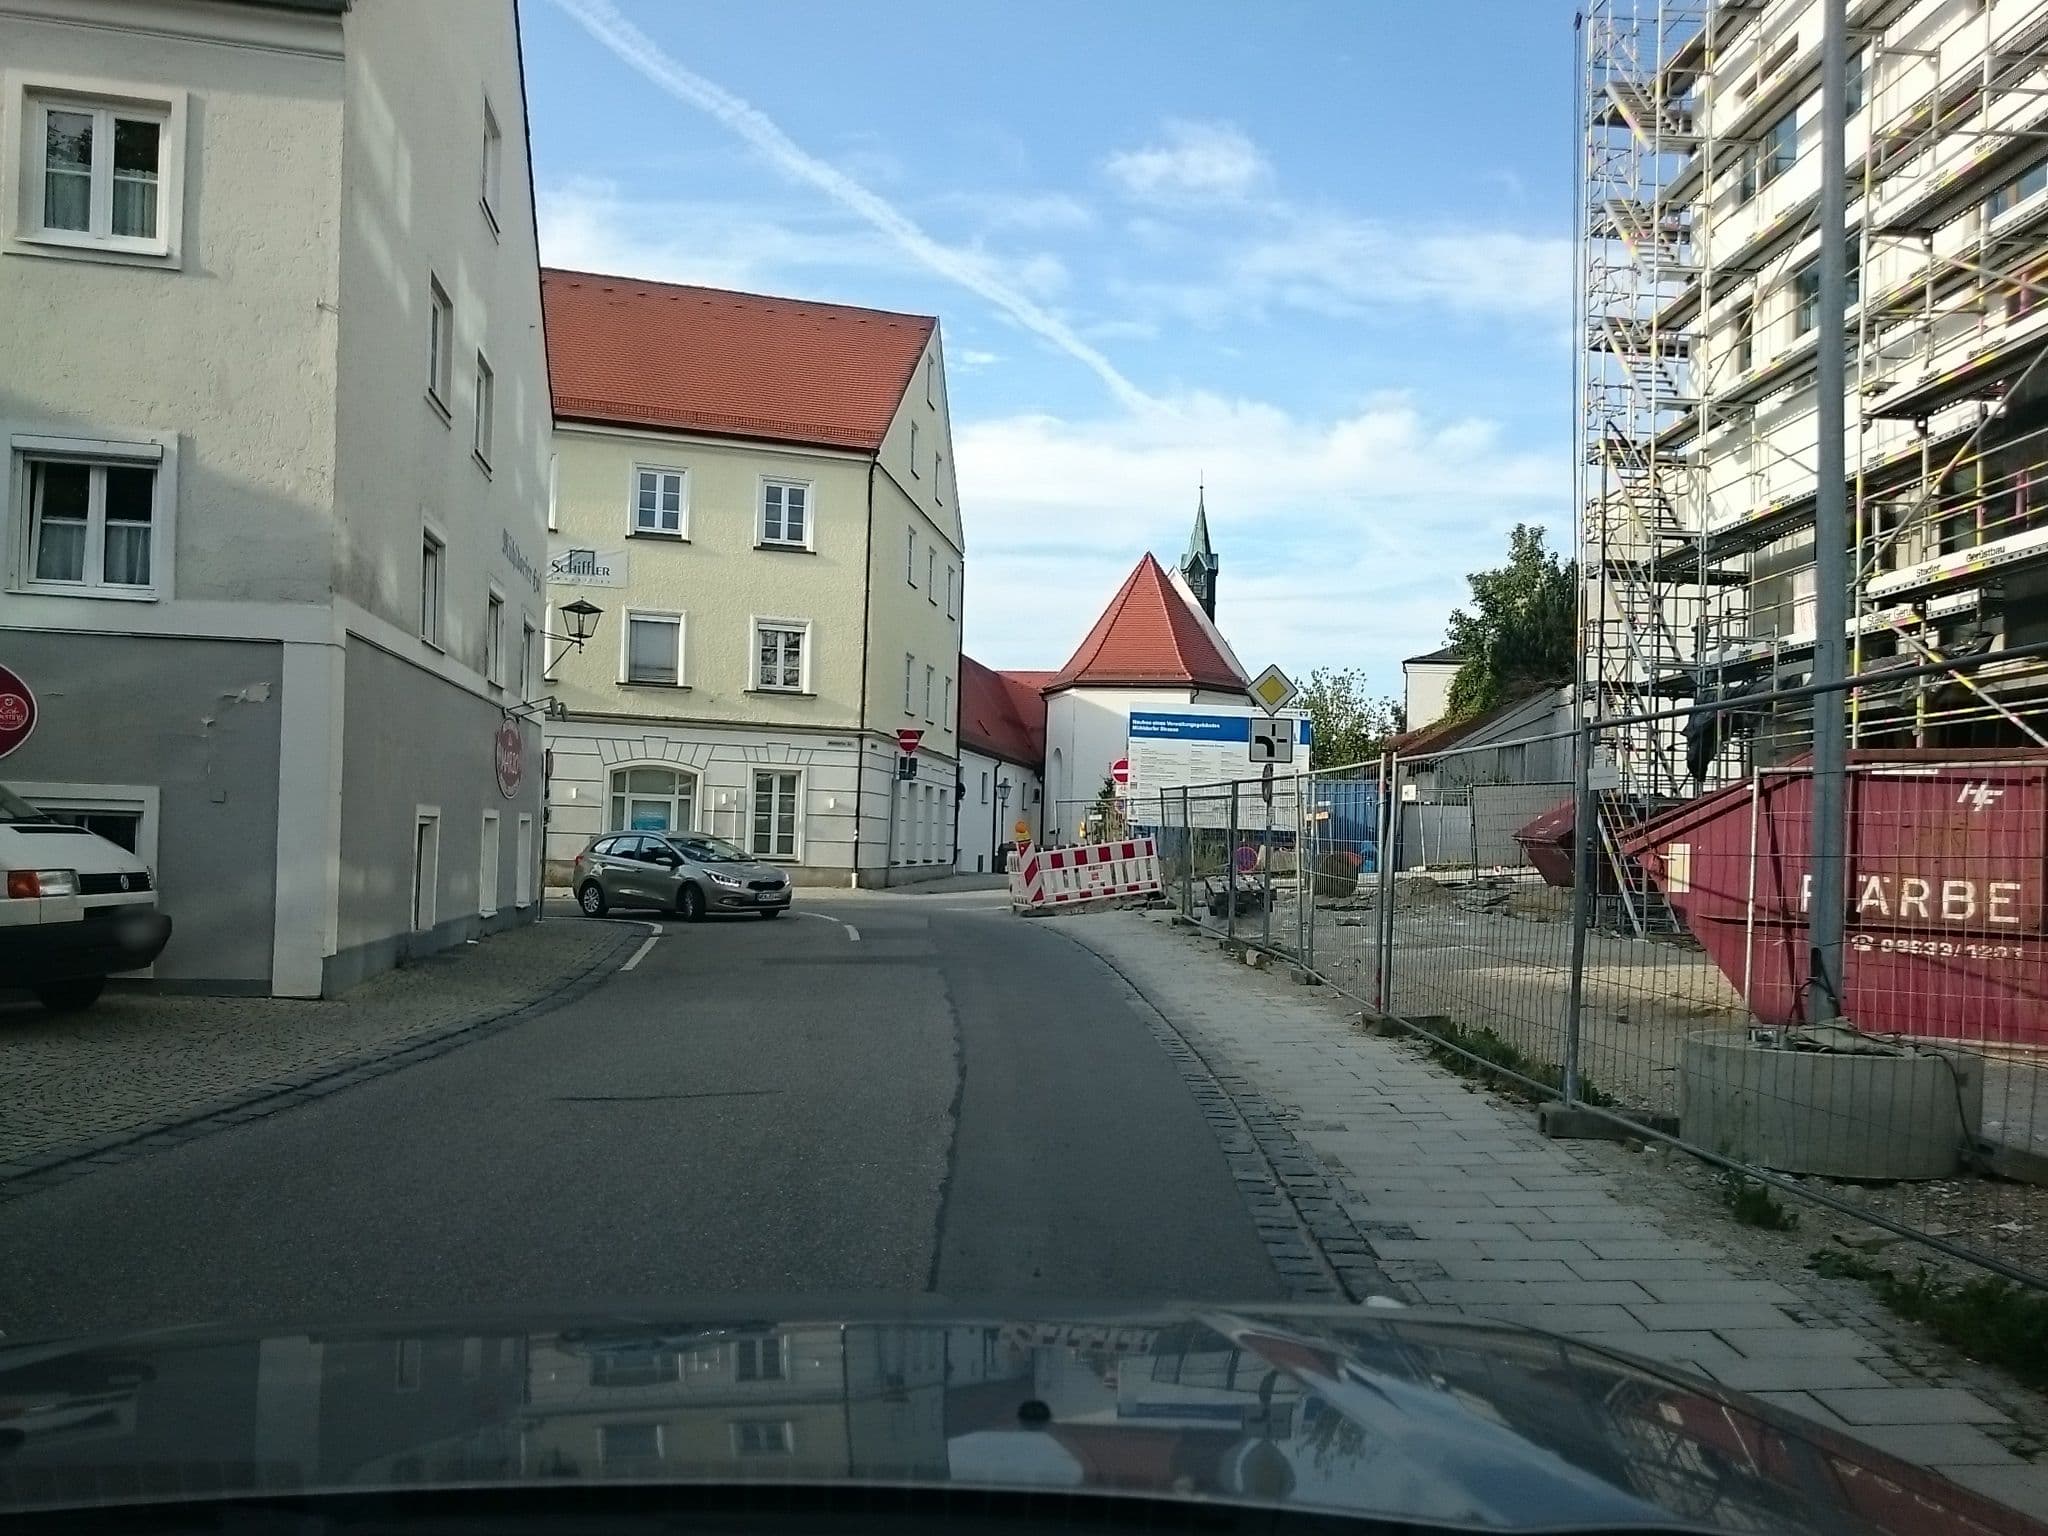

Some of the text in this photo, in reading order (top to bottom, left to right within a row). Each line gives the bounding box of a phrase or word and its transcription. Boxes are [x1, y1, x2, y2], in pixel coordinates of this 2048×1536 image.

[1916, 545, 2006, 577] Stadler Gerüstbau
[1867, 611, 1891, 626] Staer
